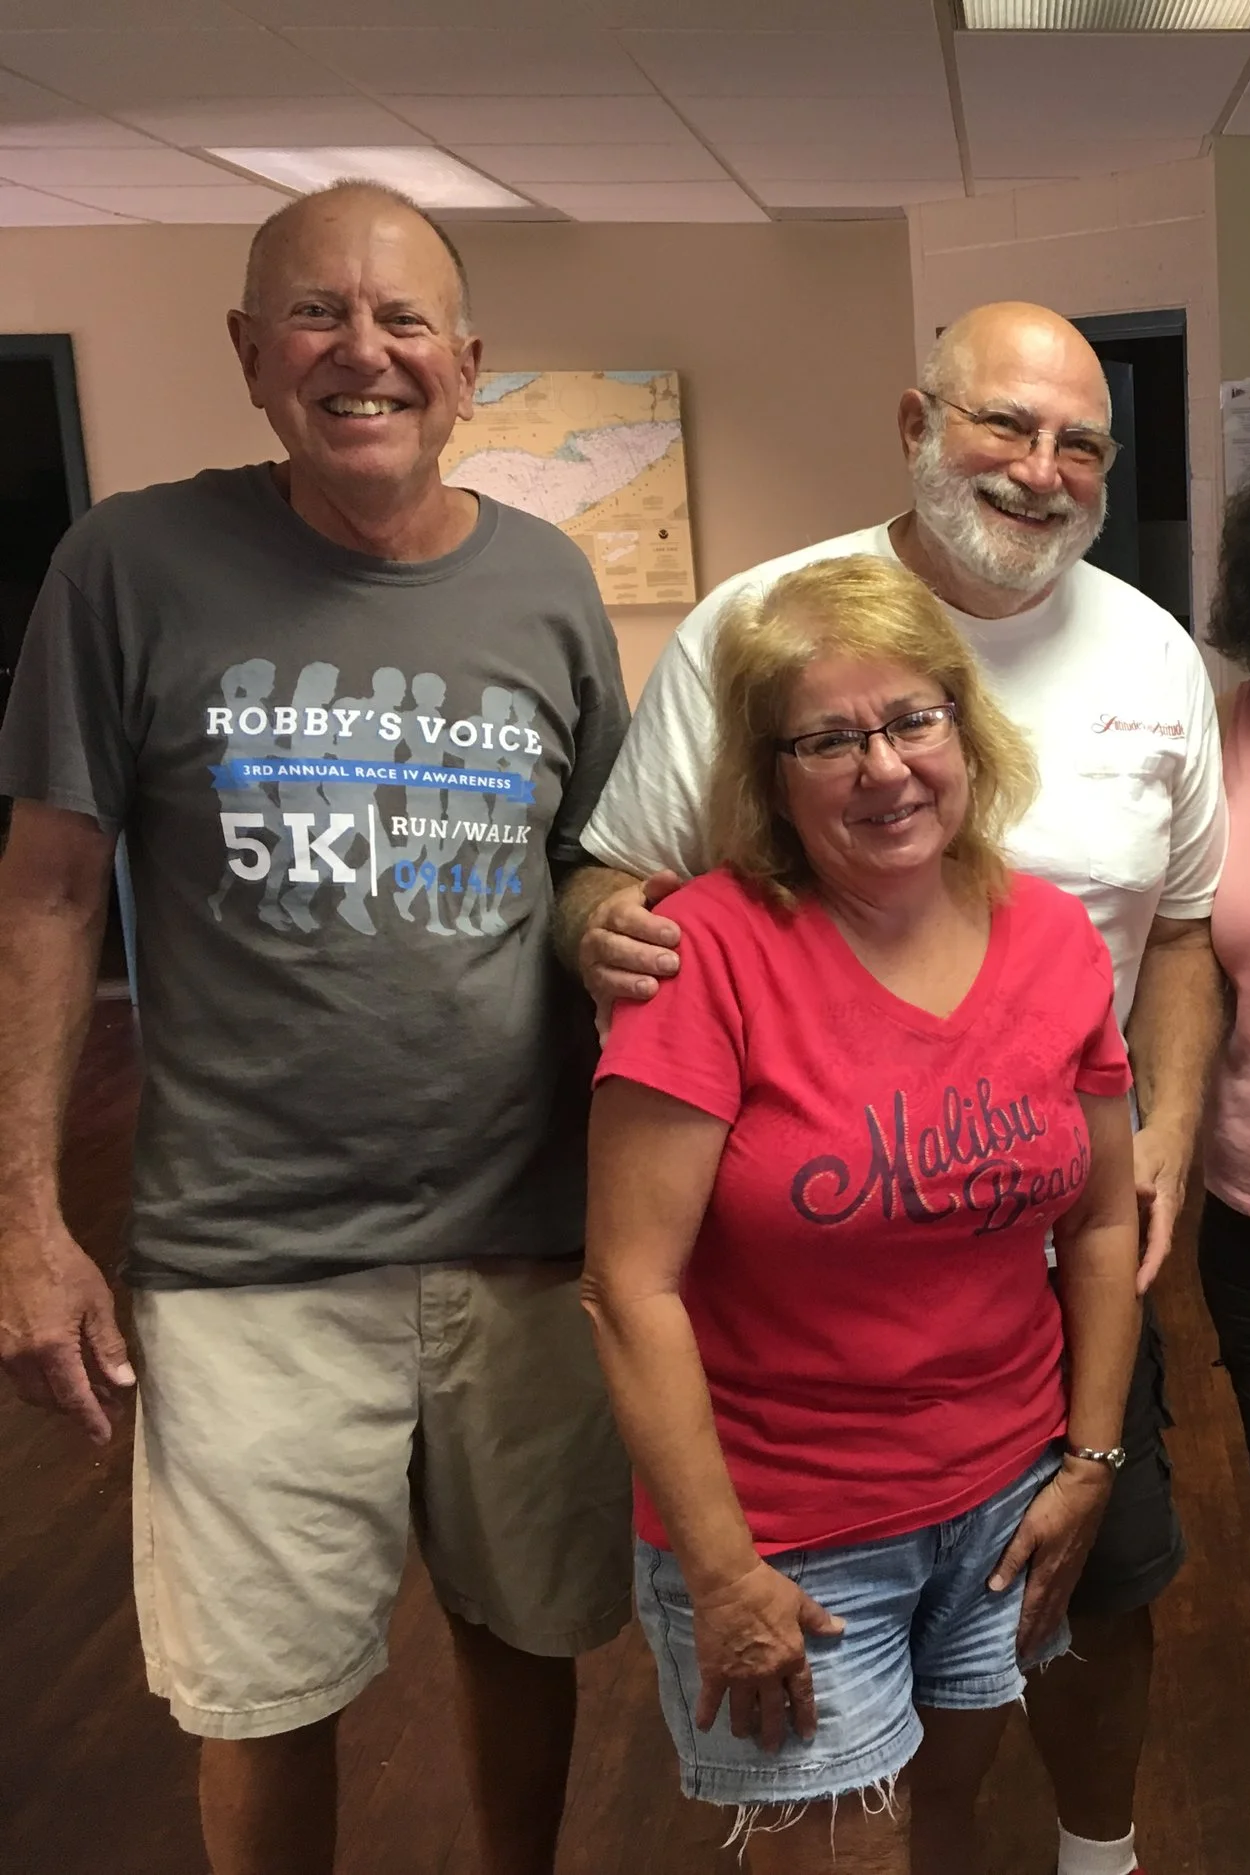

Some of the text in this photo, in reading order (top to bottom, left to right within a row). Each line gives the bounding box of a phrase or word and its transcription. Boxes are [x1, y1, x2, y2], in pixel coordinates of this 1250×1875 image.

[206, 707, 543, 755] ROBBY'S VOICE
[243, 764, 273, 776] 3RD
[278, 765, 349, 778] ANNUAL
[355, 767, 397, 780] RACE
[422, 771, 512, 790] AWARENESS
[219, 812, 532, 883] 5K RUN/WALK
[790, 1077, 1048, 1228] Malibu
[963, 1126, 1091, 1238] Beach
